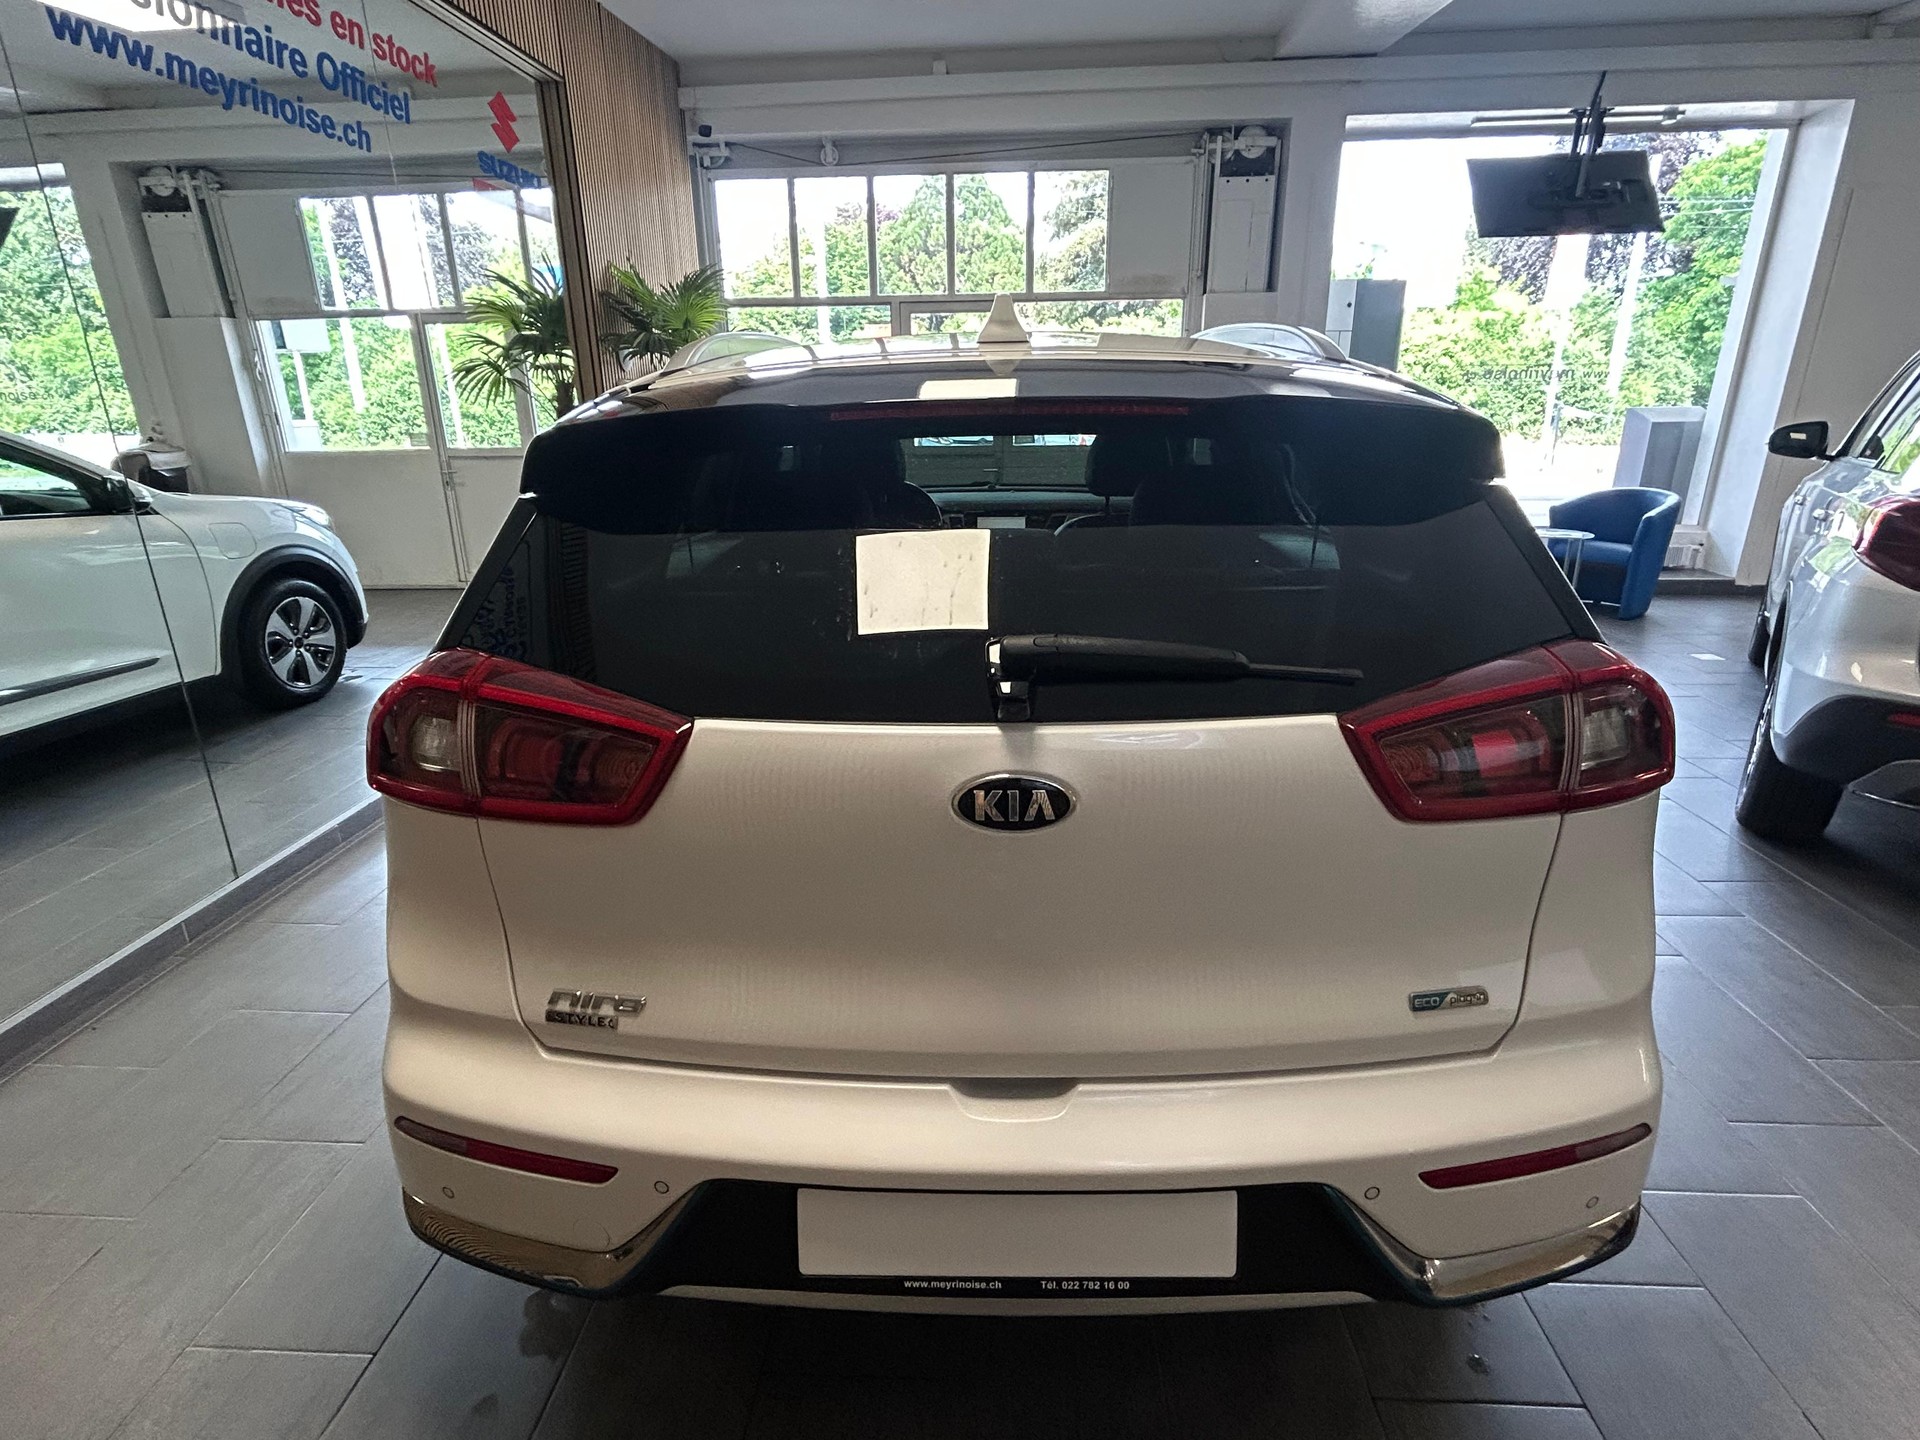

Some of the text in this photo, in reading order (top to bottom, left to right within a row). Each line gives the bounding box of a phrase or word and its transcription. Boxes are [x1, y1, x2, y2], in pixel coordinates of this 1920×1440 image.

[267, 0, 438, 88] es en stock
[45, 4, 372, 153] www.meyrinoise.ch
[316, 51, 411, 125] Officiel
[973, 788, 1056, 822] KIA
[903, 1280, 1002, 1290] www.meyrinoise.ch
[1061, 1281, 1080, 1290] 022
[1082, 1281, 1100, 1290] 782
[1117, 1281, 1130, 1290] 00
